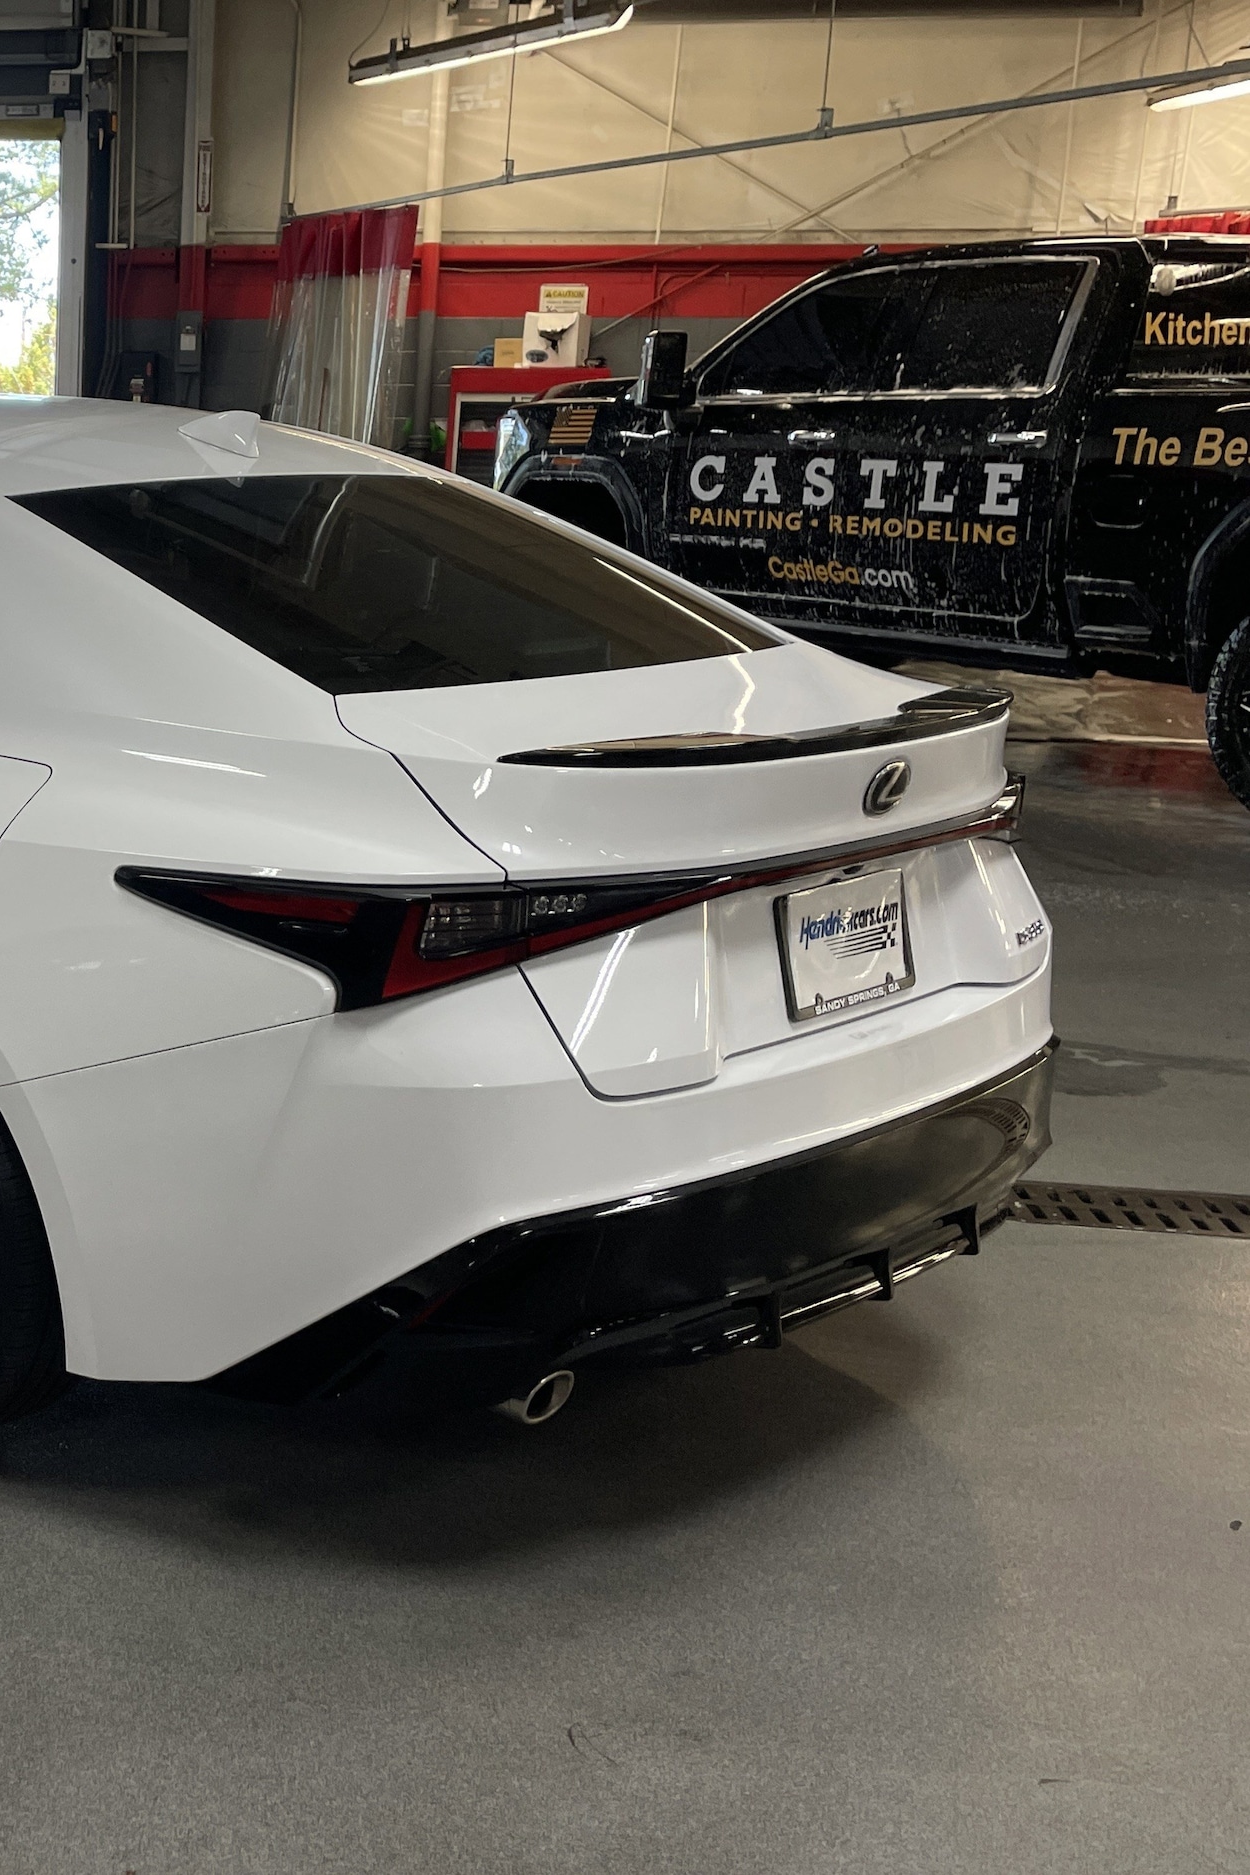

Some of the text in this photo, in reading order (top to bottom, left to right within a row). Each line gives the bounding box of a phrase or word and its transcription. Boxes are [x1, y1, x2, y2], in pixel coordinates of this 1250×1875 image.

[553, 290, 584, 298] CAUTION
[1112, 427, 1250, 467] The Be
[690, 454, 1024, 517] CASTLE
[689, 506, 1016, 546] PAINTING REMODELING
[768, 556, 913, 590] CastleGa.com
[800, 902, 898, 950] Hendrikcars.com
[815, 982, 900, 1015] SANDY SPRINGS, GA
